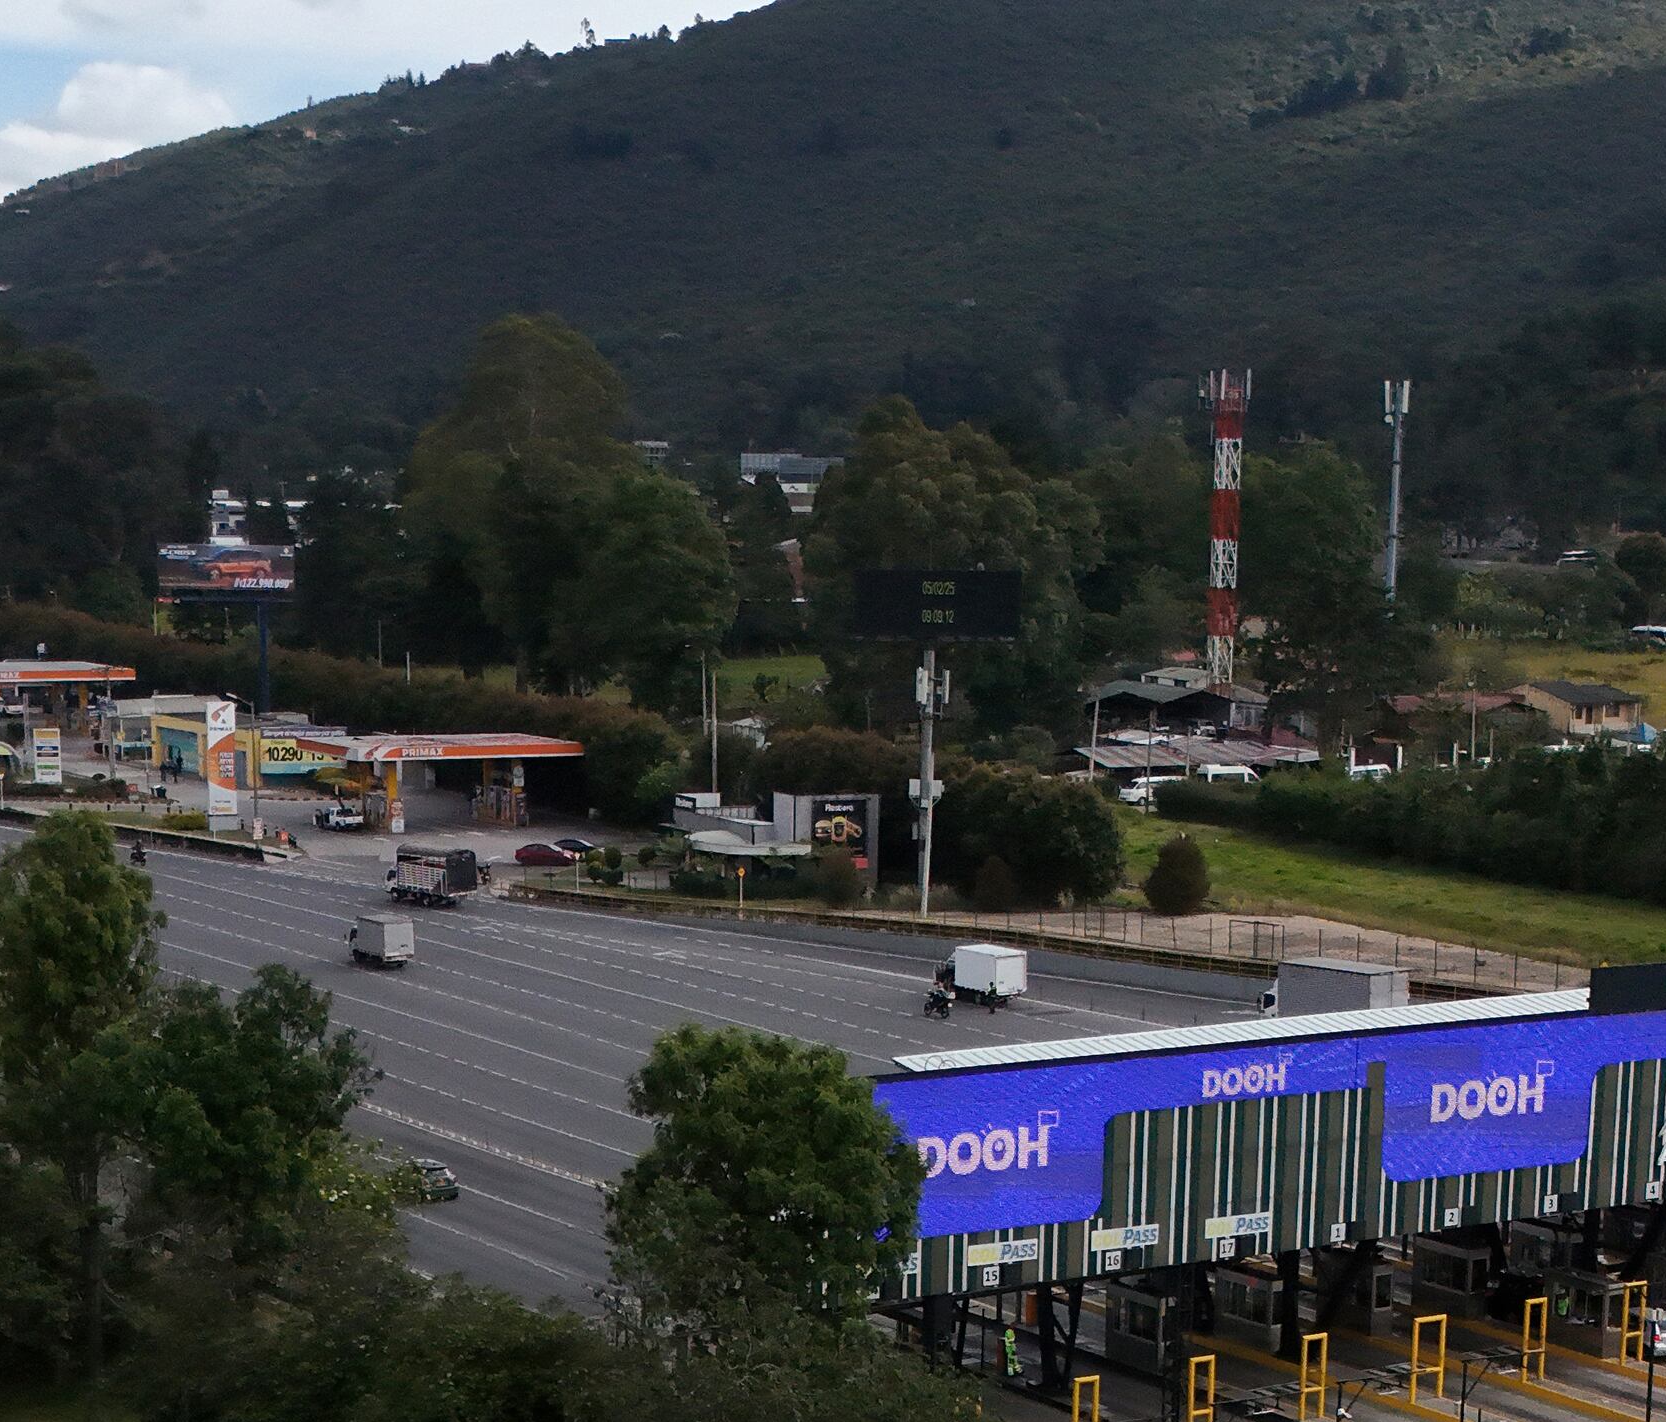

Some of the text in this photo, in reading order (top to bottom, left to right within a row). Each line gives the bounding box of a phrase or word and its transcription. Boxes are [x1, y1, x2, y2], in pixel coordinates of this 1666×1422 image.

[402, 747, 443, 757] PRIMAX
[1202, 1063, 1285, 1098] DOOH
[1430, 1074, 1545, 1123] DOOH
[917, 1126, 1048, 1178] DOOH
[1650, 1185, 1656, 1195] 4
[1549, 1199, 1554, 1208] 3
[1449, 1212, 1454, 1222] 2
[1335, 1228, 1341, 1238] 1
[1221, 1242, 1233, 1254] 17
[1107, 1255, 1120, 1267] 16
[985, 1270, 998, 1282] 15
